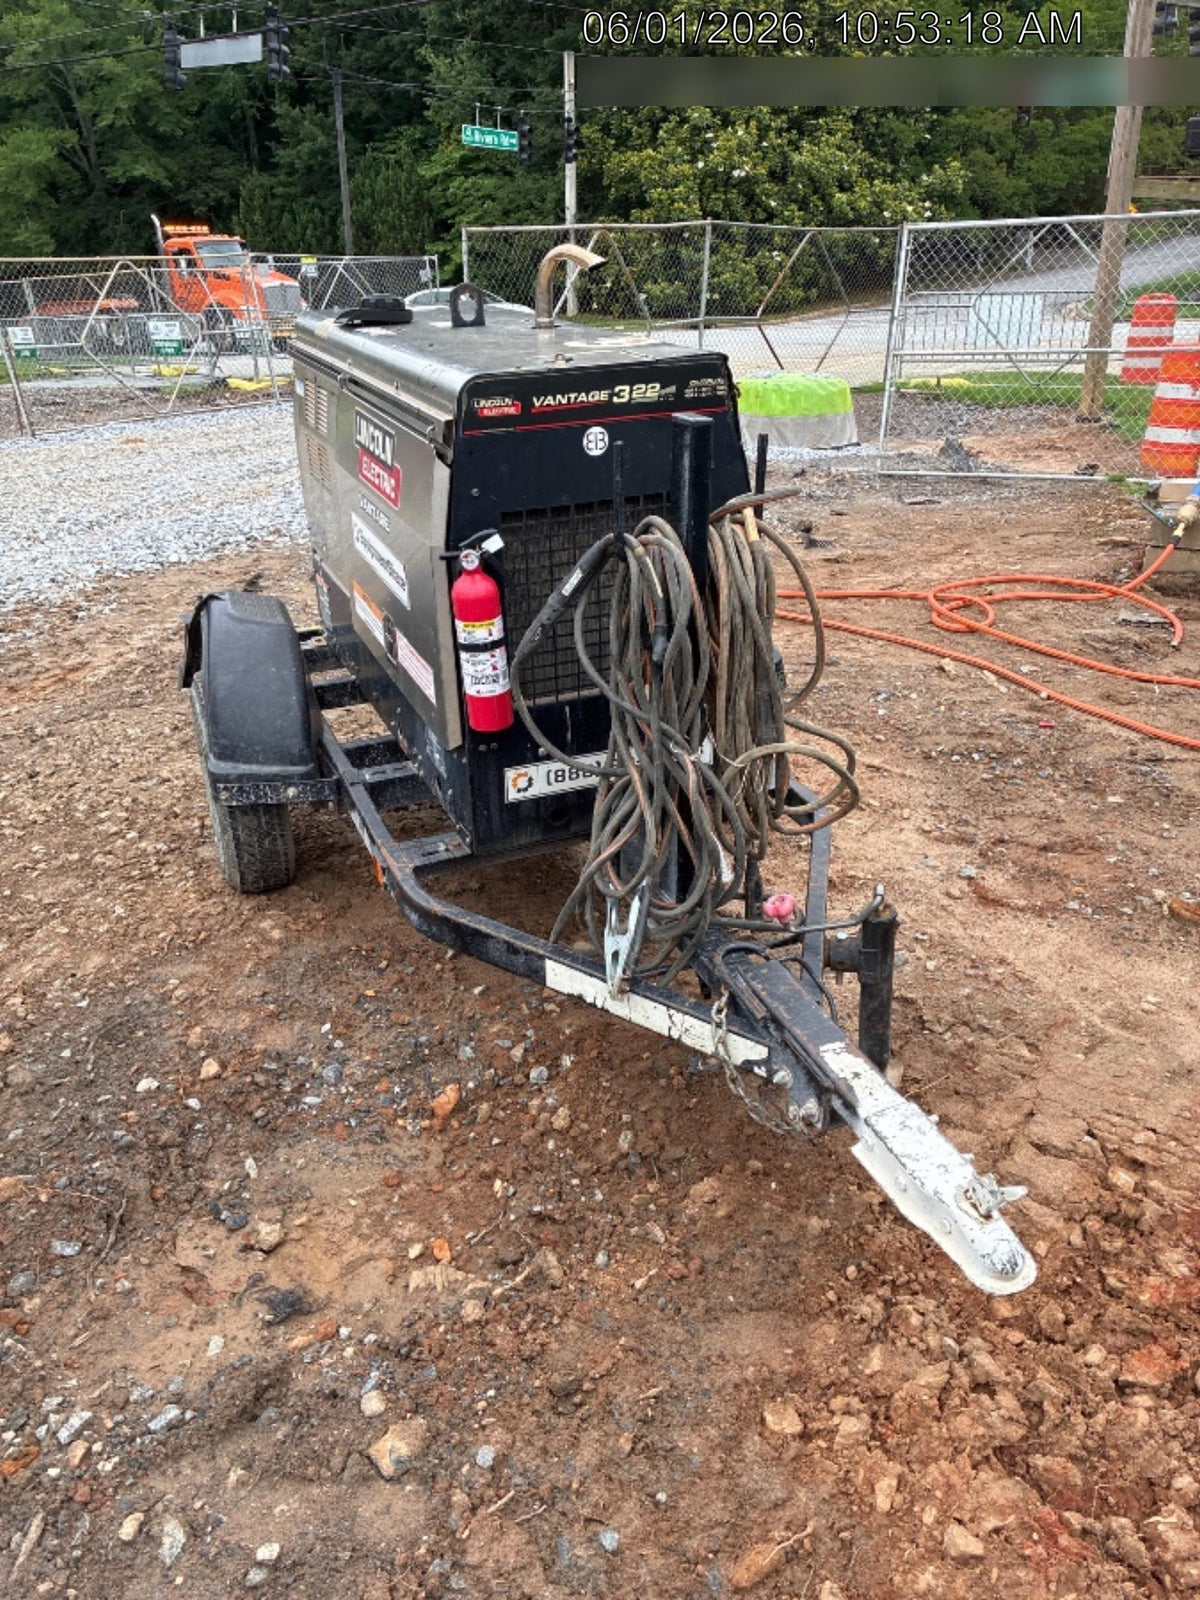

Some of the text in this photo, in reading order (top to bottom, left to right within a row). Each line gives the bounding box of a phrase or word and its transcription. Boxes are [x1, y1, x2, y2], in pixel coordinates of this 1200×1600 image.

[474, 397, 513, 408] LINCOLN
[532, 390, 610, 408] VANTAGE
[612, 382, 660, 403] 322
[356, 414, 395, 467] LINCOLN
[362, 455, 396, 500] ELECTRIC
